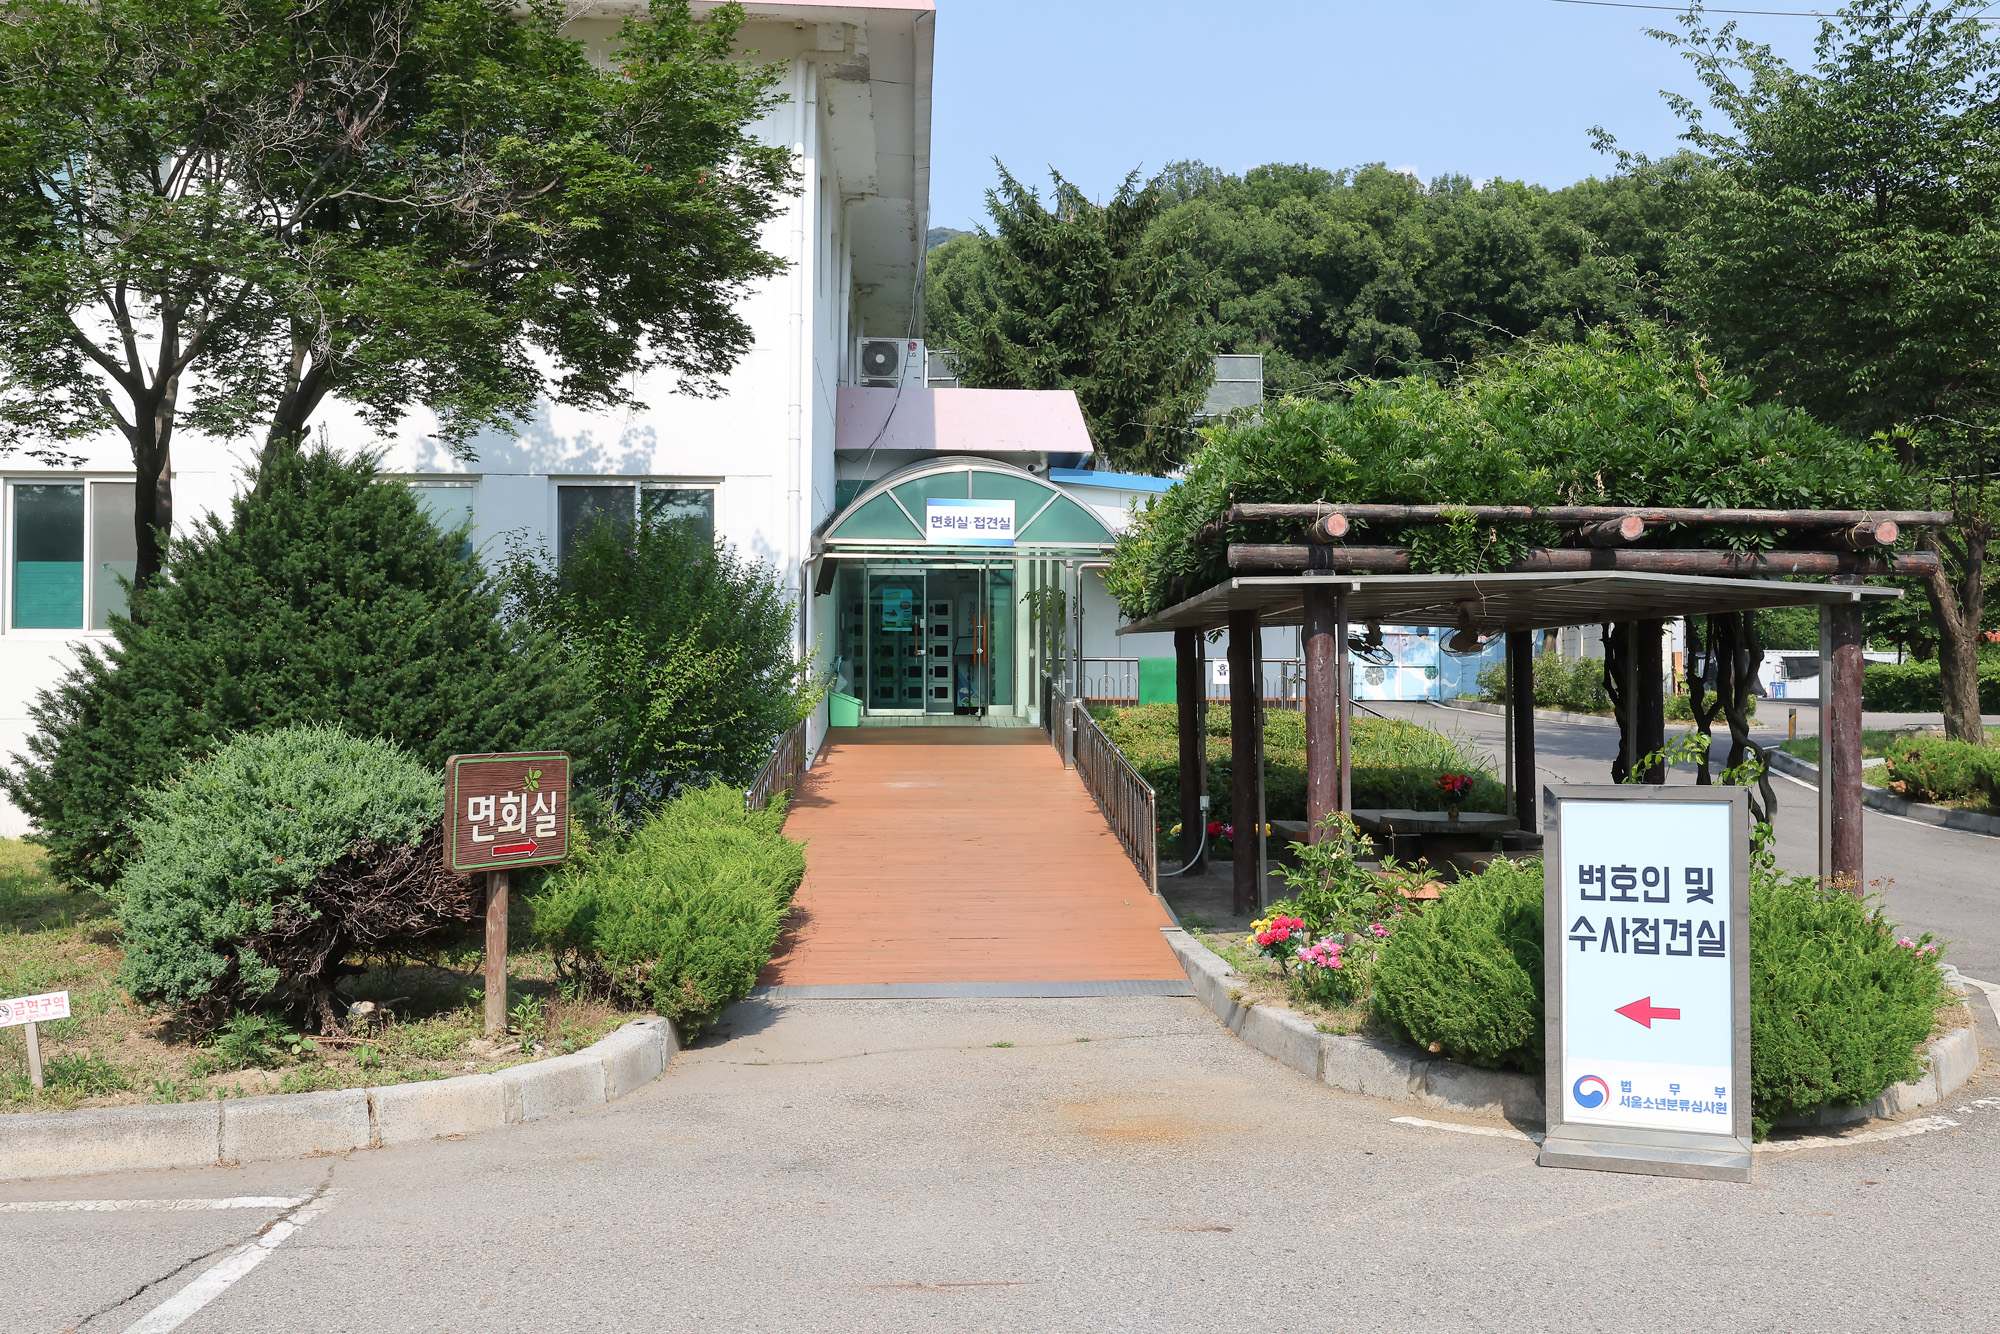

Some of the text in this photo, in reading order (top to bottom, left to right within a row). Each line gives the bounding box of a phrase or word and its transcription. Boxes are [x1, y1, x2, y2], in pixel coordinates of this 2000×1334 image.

[931, 515, 1011, 530] 면회실·접견실
[467, 790, 557, 843] 면회실
[1578, 864, 1714, 905] 변호인 및
[1568, 915, 1726, 958] 수사접견실
[14, 996, 65, 1016] 금연구역
[25, 1012, 50, 1020] SMOKING
[1619, 1095, 1727, 1115] 서울소년분류심사원
